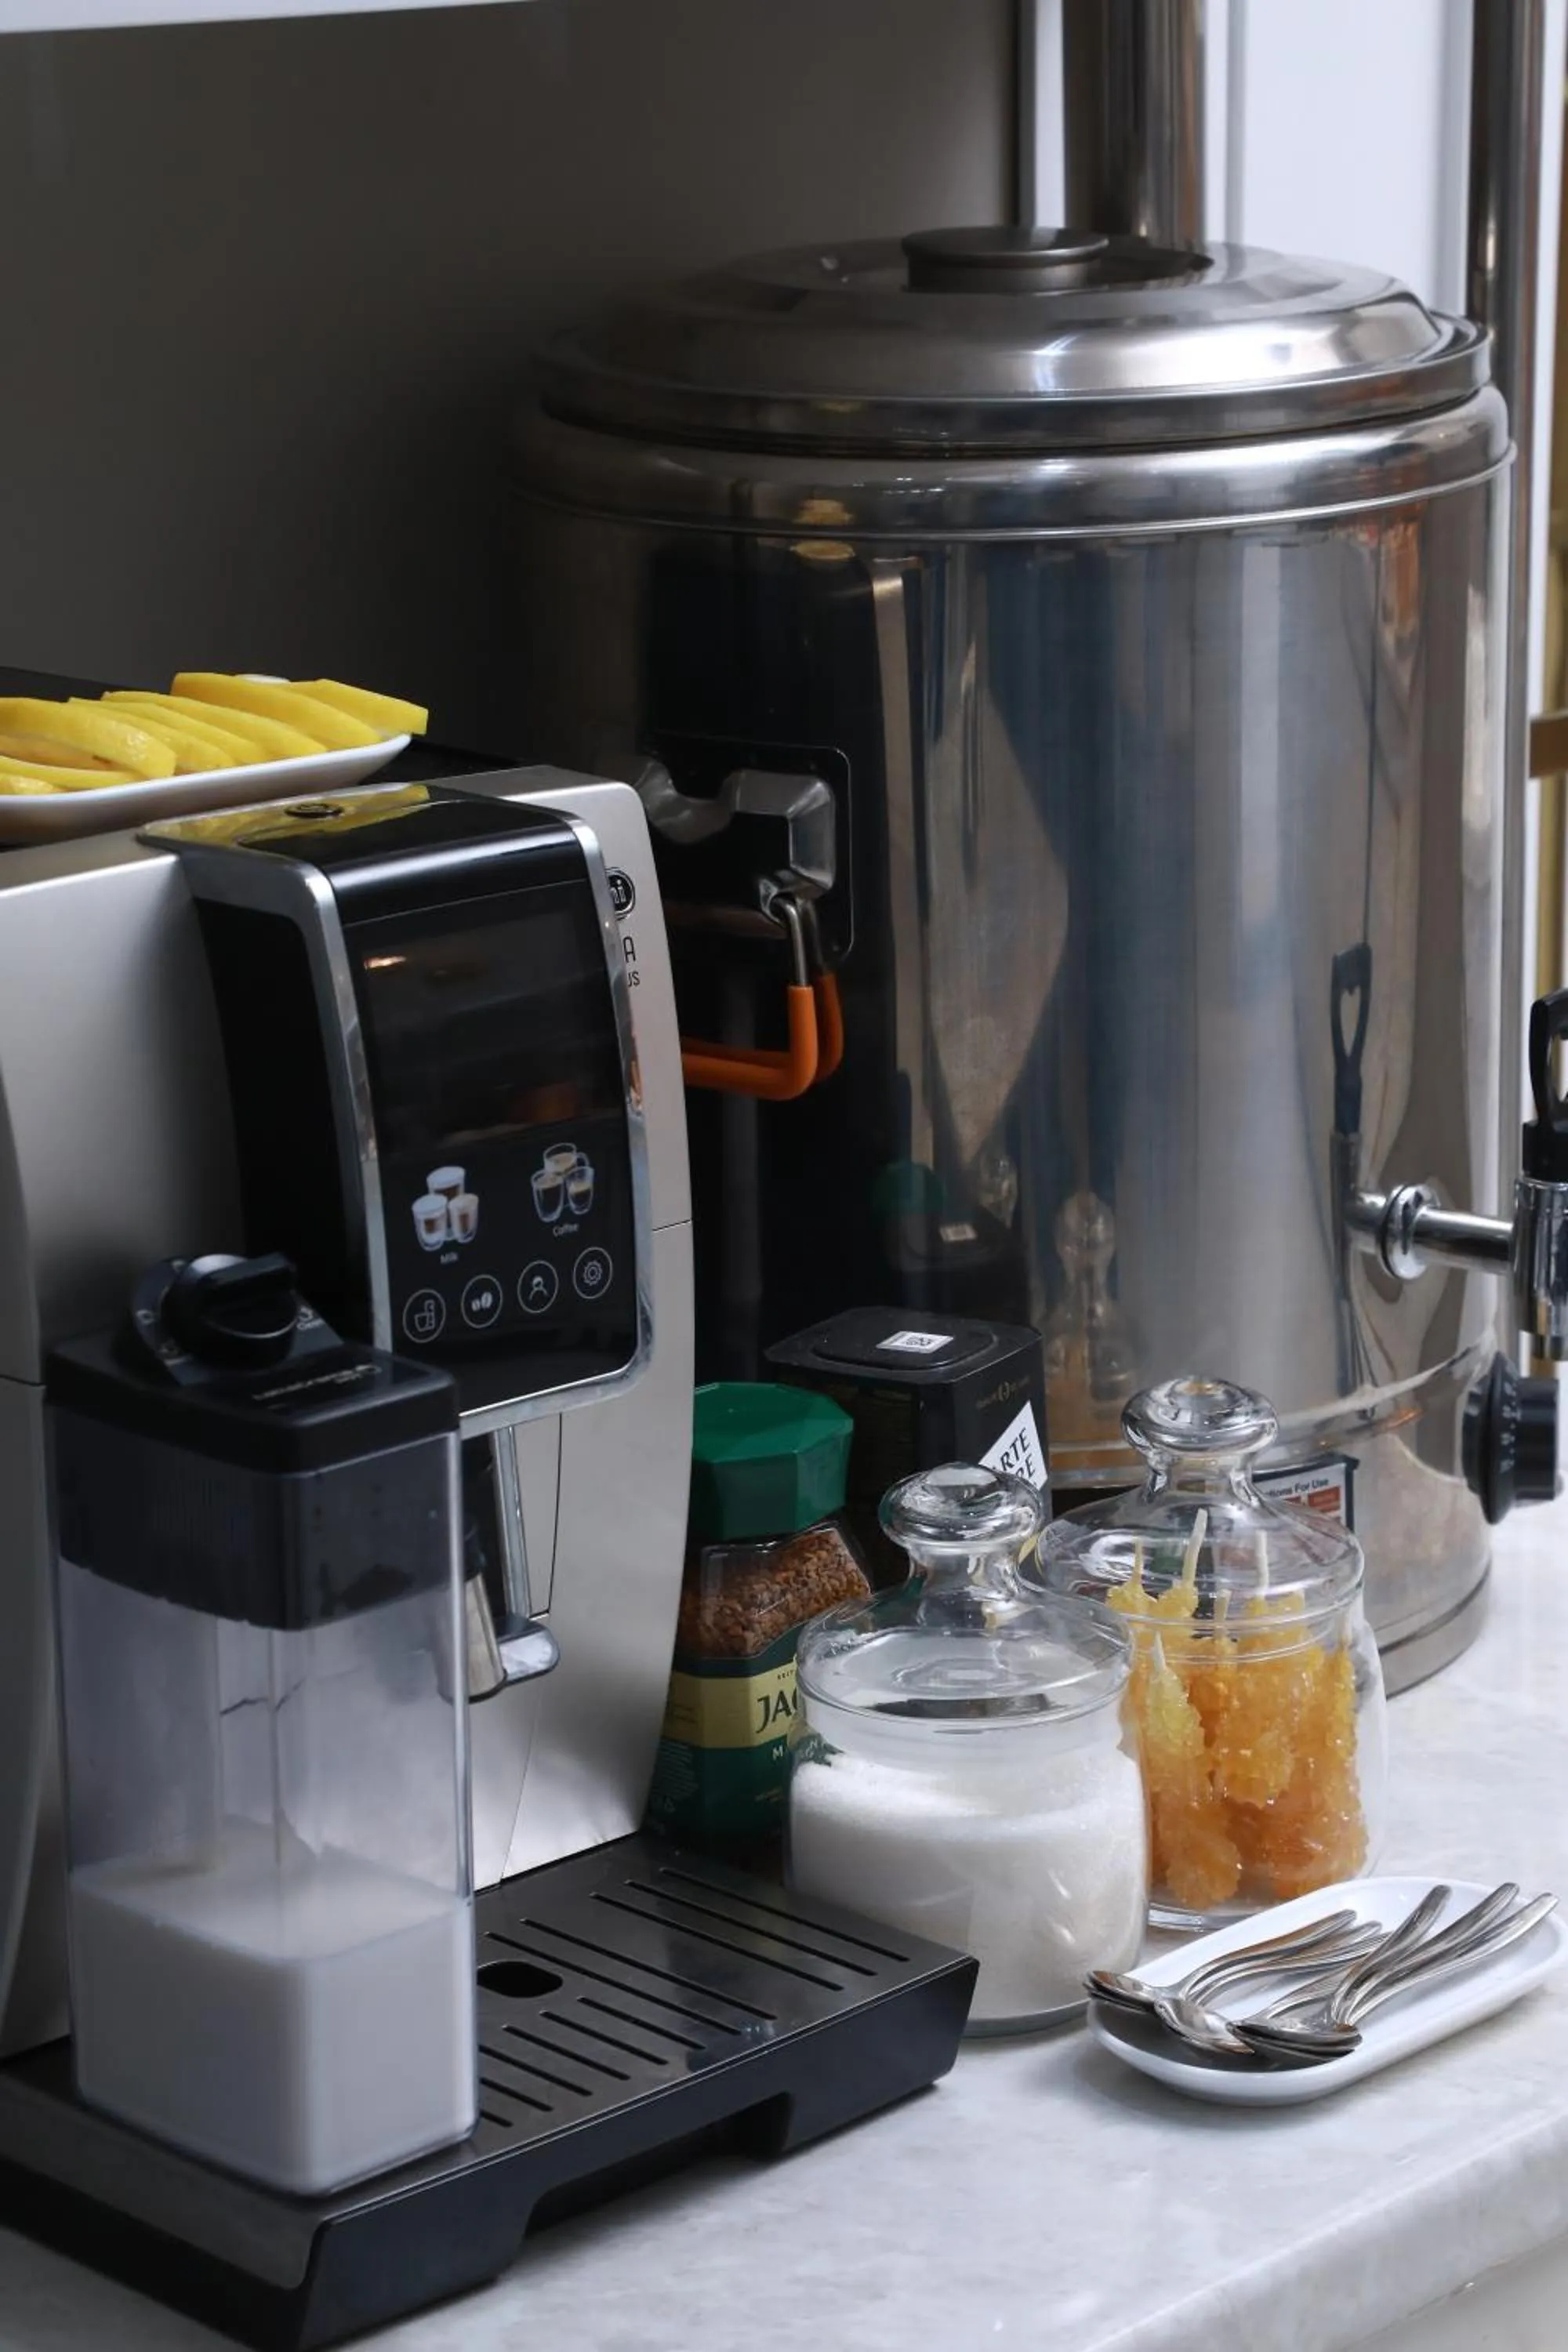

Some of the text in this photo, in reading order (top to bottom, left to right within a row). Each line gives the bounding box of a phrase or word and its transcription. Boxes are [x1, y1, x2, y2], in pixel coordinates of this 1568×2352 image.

[553, 1223, 579, 1236] Coffee
[441, 1252, 459, 1264] Milk
[993, 1427, 1030, 1471] RTE
[1294, 1483, 1309, 1493] For
[1312, 1479, 1329, 1489] Use
